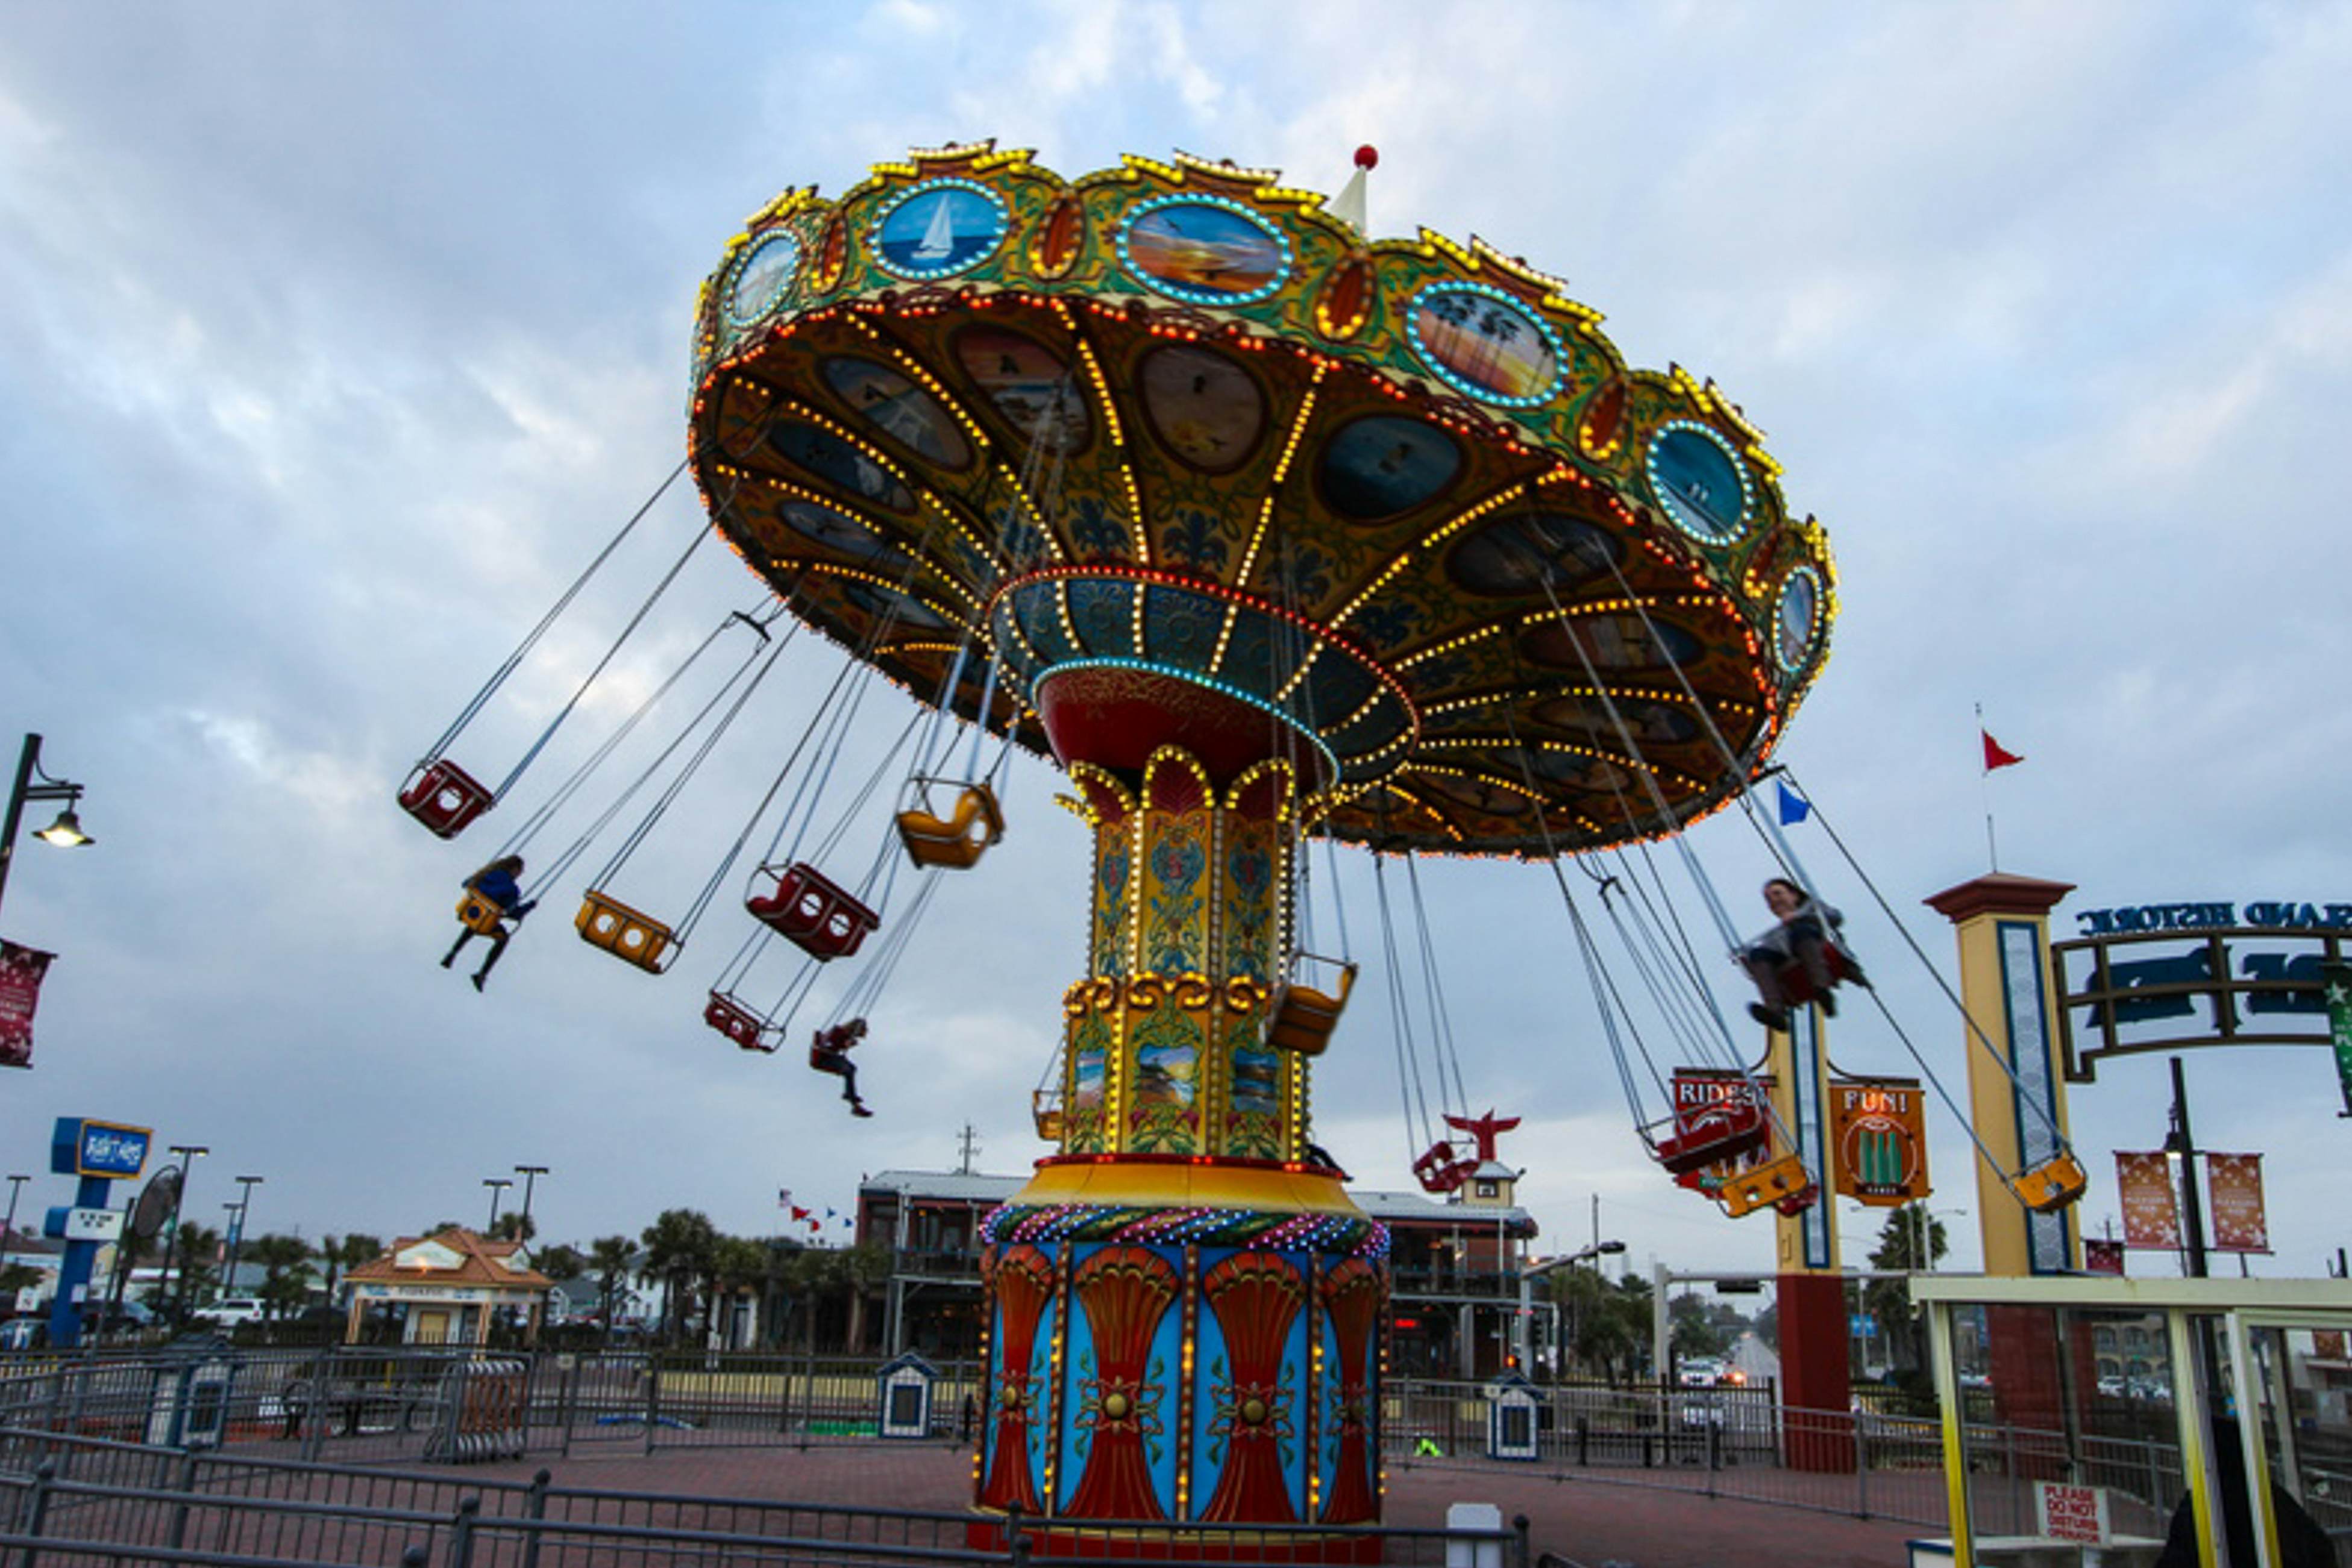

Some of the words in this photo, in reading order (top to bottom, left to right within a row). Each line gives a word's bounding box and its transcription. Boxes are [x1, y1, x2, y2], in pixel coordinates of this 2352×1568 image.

[1843, 1090, 1907, 1113] FUN!
[2044, 1485, 2093, 1502] PLEASE
[2047, 1497, 2065, 1514] DO
[2069, 1503, 2097, 1516] NOT
[2048, 1515, 2098, 1531] DISTURB
